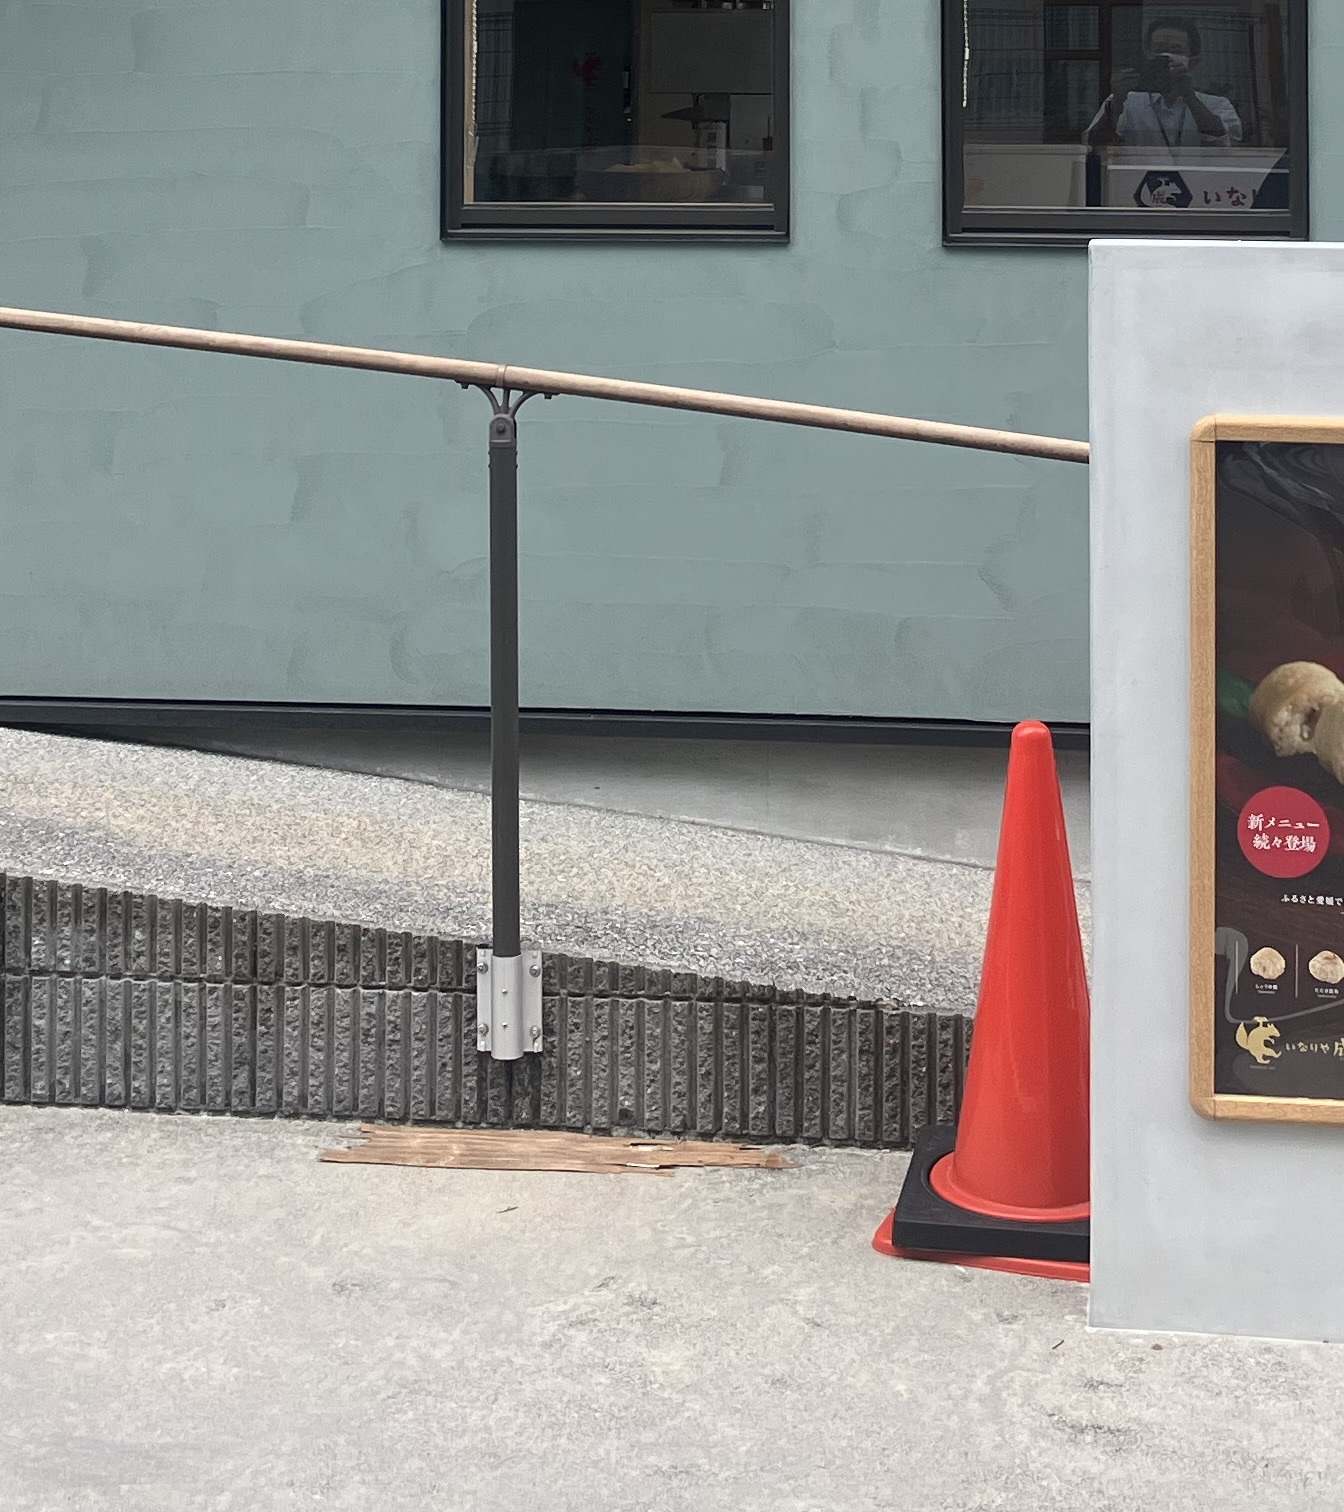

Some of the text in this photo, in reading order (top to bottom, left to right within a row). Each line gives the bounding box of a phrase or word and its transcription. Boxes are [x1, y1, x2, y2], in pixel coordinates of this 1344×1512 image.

[1247, 813, 1320, 831] 新メニュー
[1253, 833, 1316, 853] 続々登場
